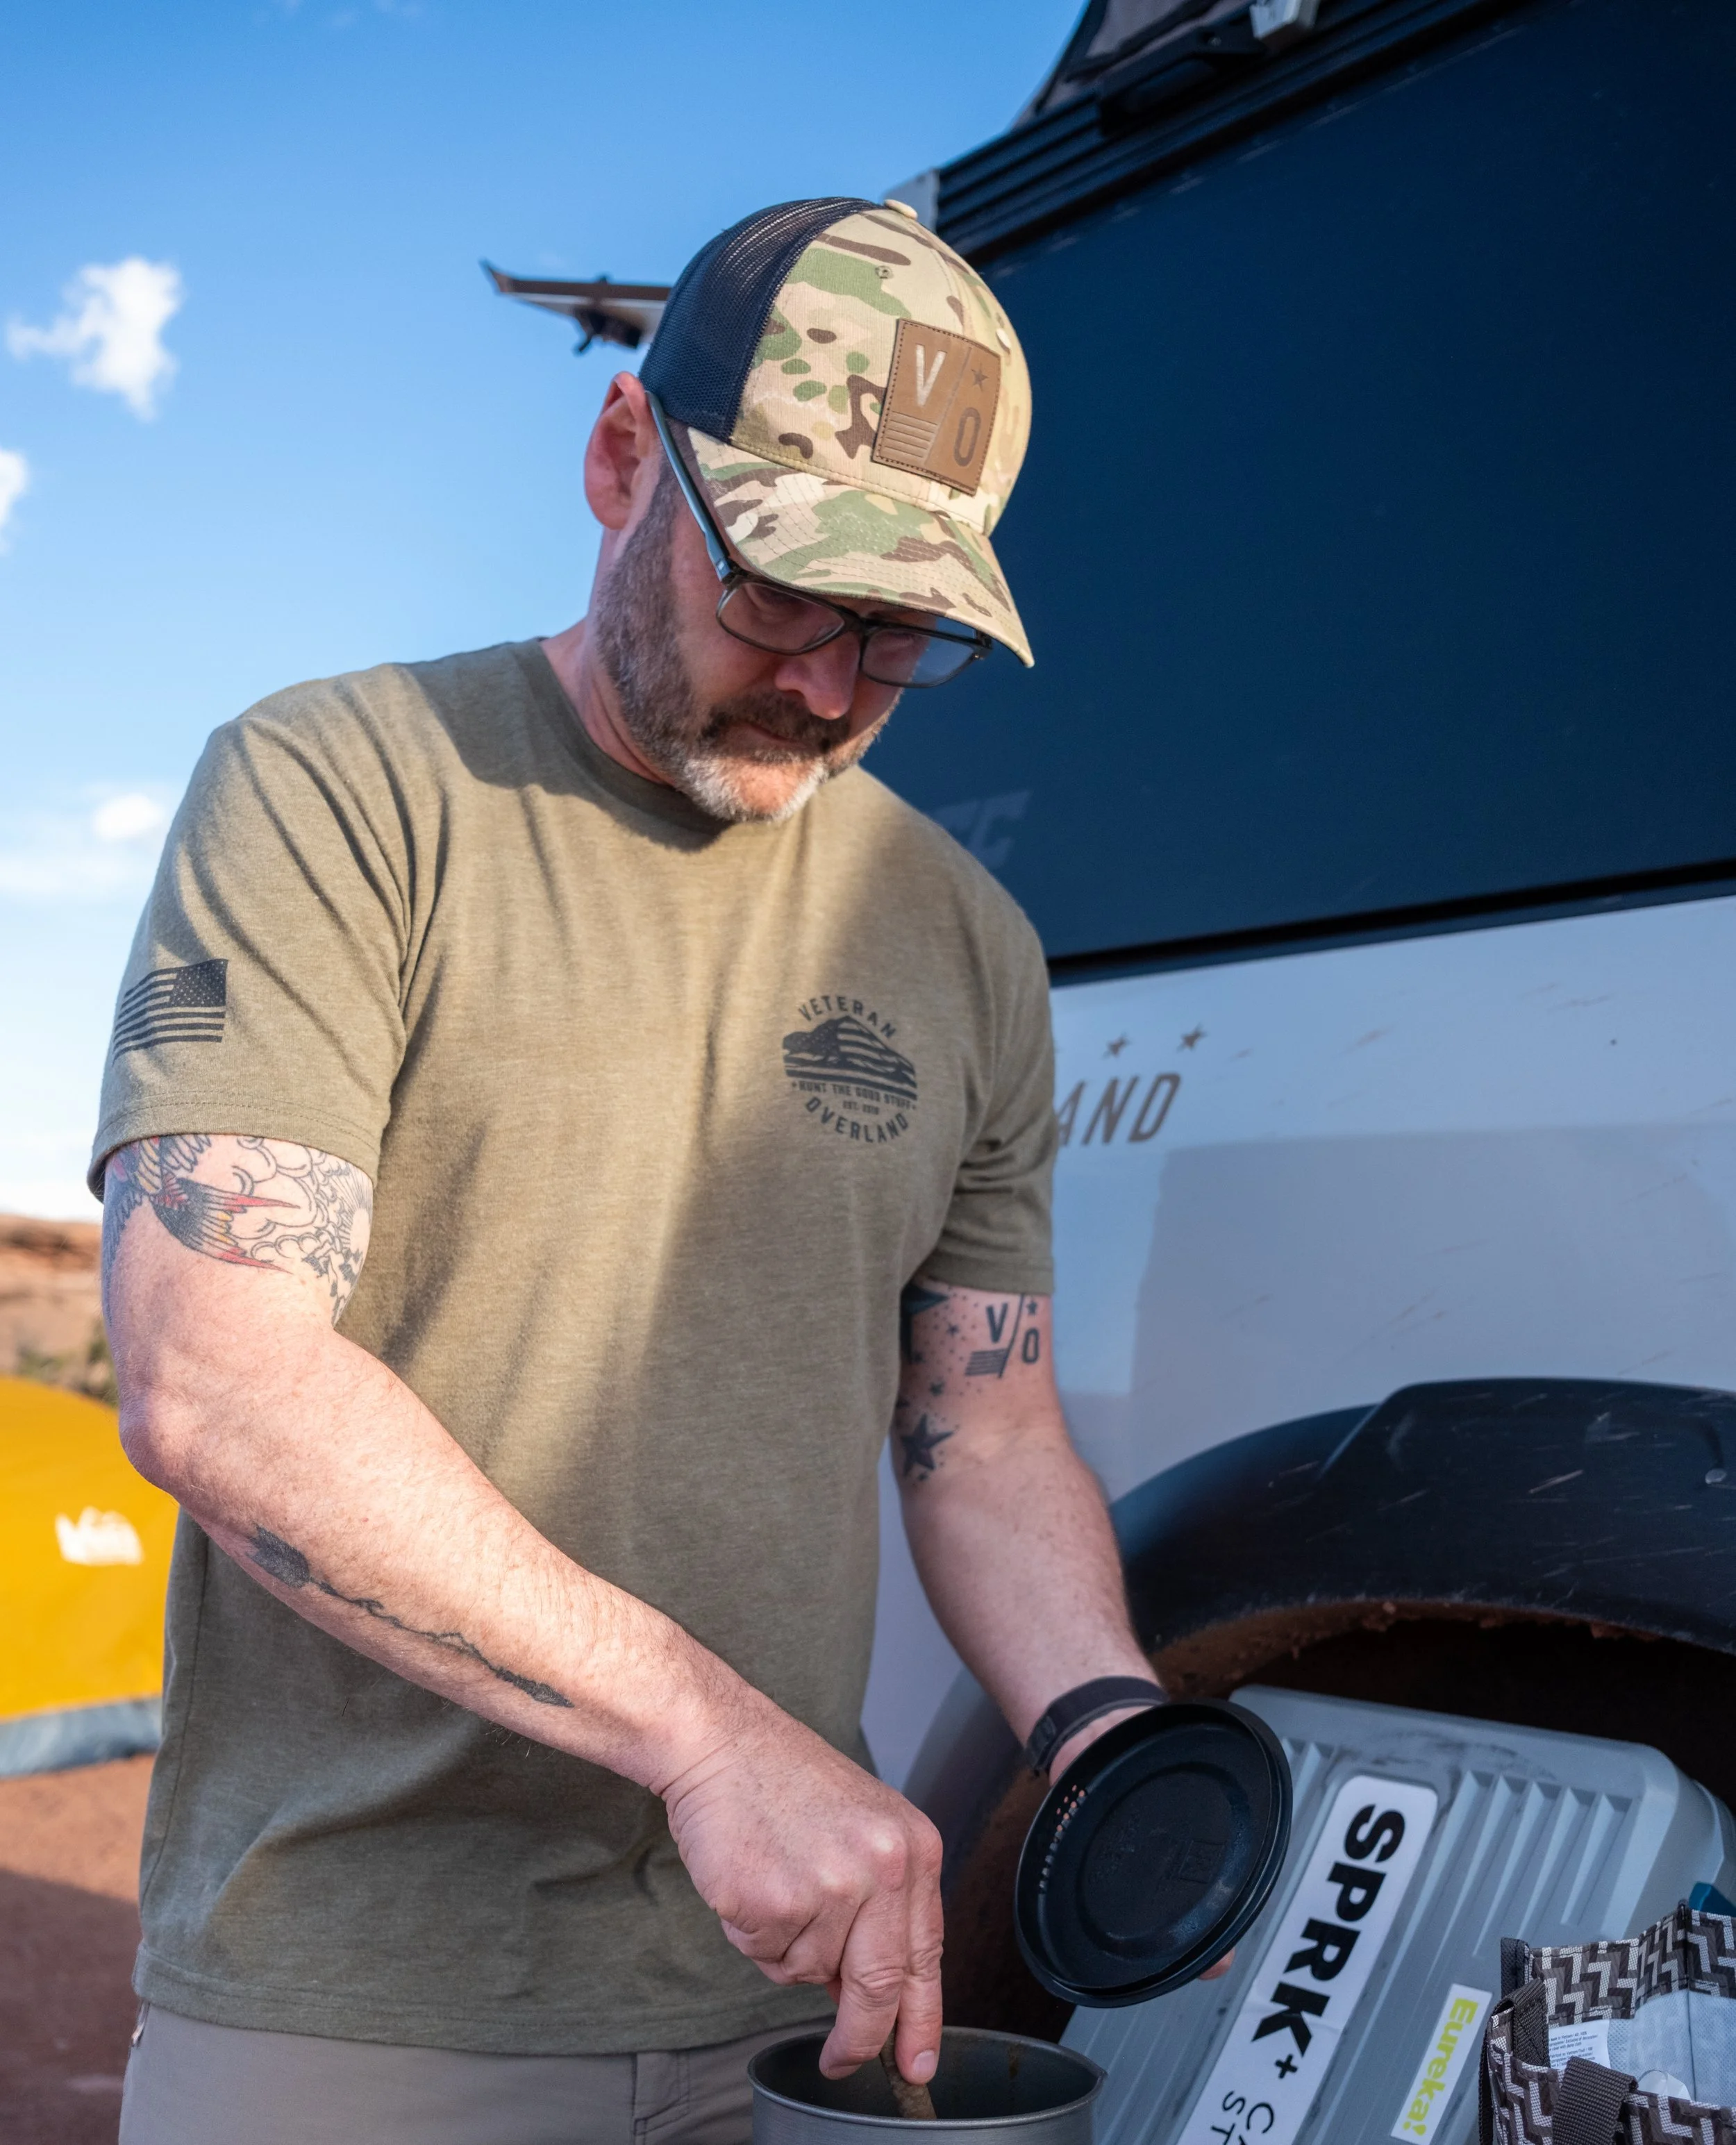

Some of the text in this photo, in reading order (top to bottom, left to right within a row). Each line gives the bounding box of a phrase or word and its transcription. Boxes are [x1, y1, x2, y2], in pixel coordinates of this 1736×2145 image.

[915, 343, 947, 407] V
[798, 995, 896, 1038] VETERAN
[805, 1096, 909, 1144] OVERLAND
[1402, 1997, 1479, 2137] Eureka!
[1238, 2102, 1274, 2145] C
